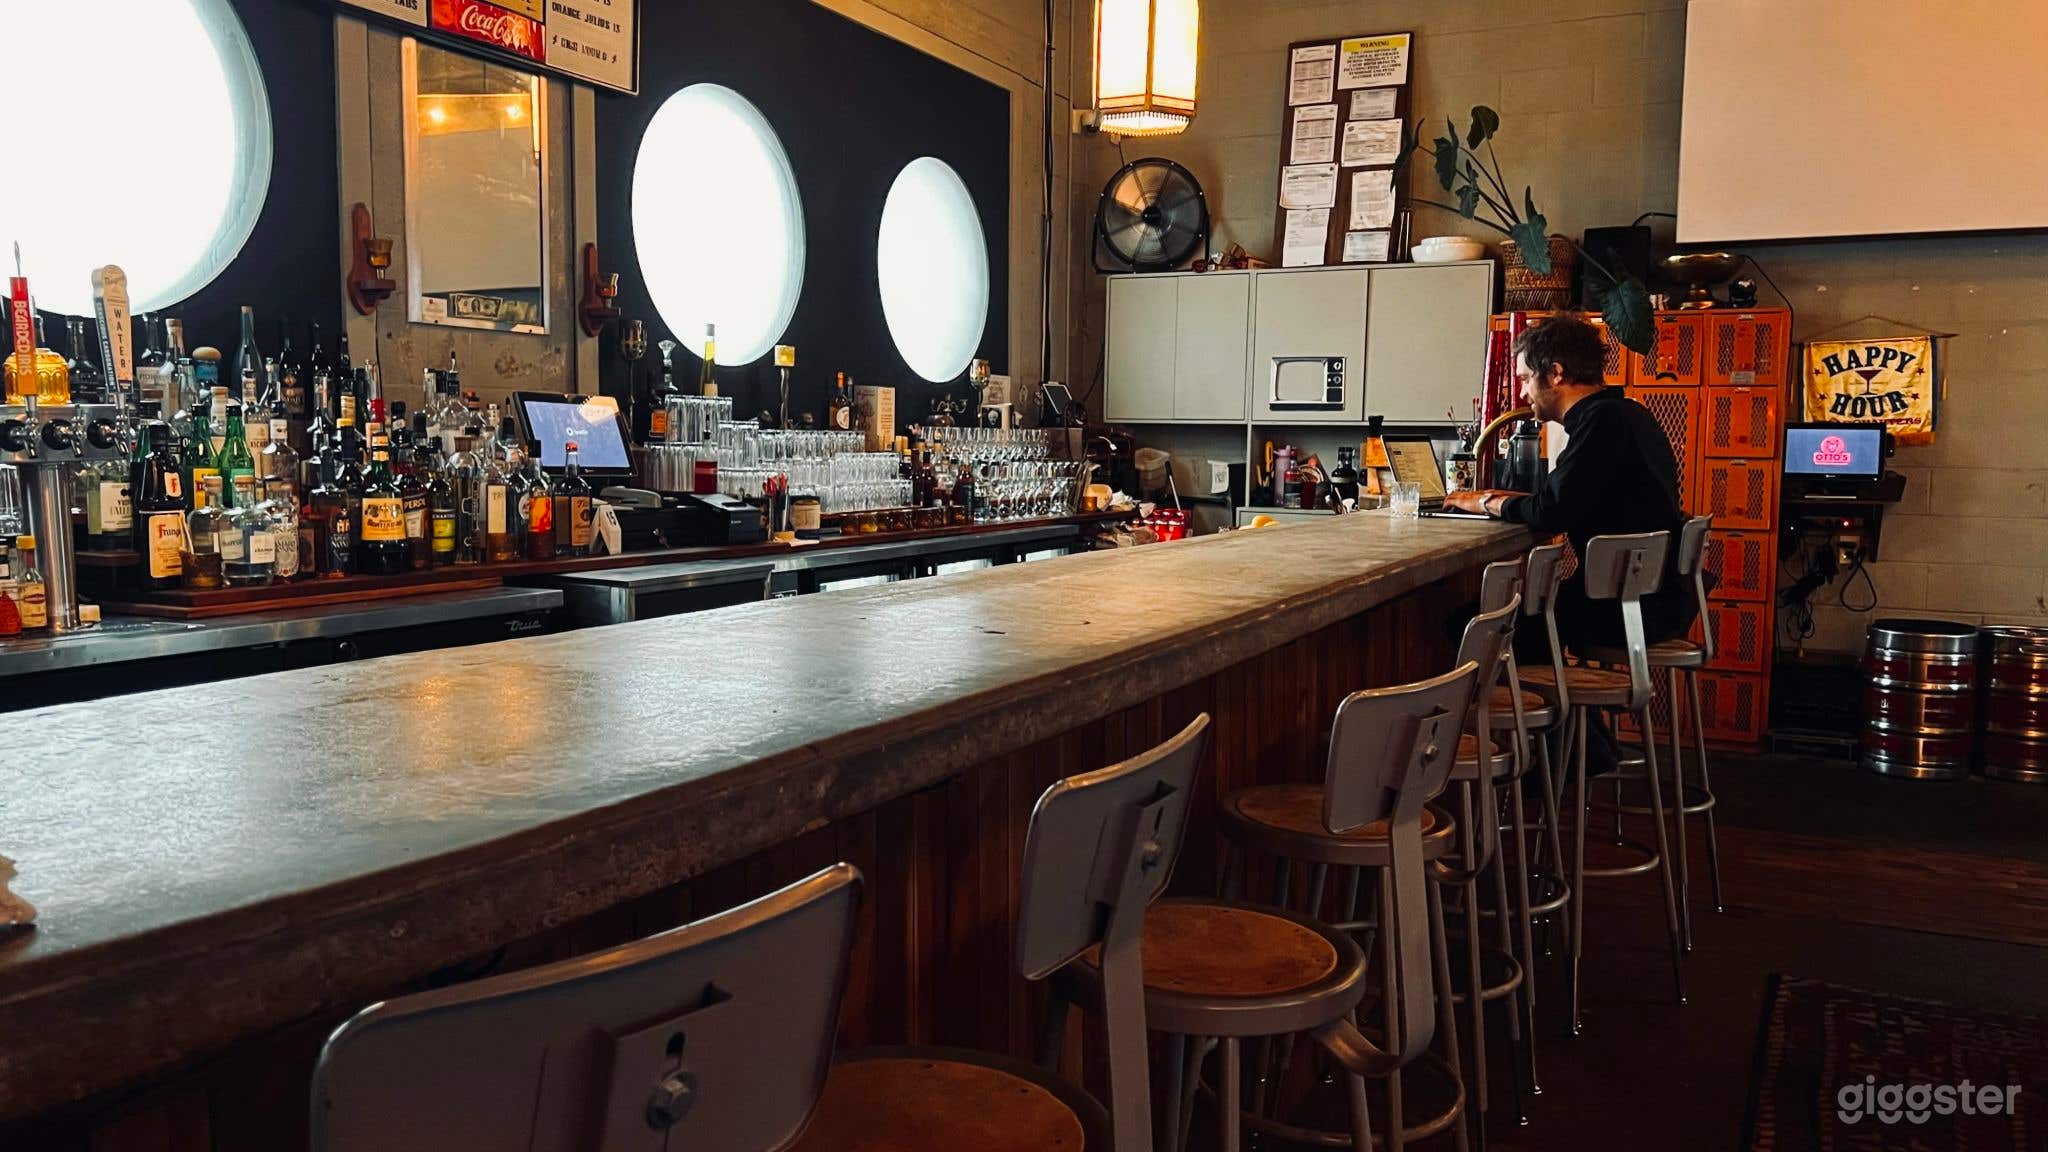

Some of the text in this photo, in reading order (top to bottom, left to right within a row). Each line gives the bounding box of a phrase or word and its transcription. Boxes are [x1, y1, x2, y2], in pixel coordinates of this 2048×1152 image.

[552, 1, 581, 20] ORANGE
[584, 14, 610, 30] JULIUS
[14, 300, 33, 376] BEARDED IRIS
[113, 309, 126, 368] WATER
[1821, 346, 1917, 377] HAPPY
[1829, 391, 1909, 418] HOUR
[1815, 453, 1848, 461] OTTO'S
